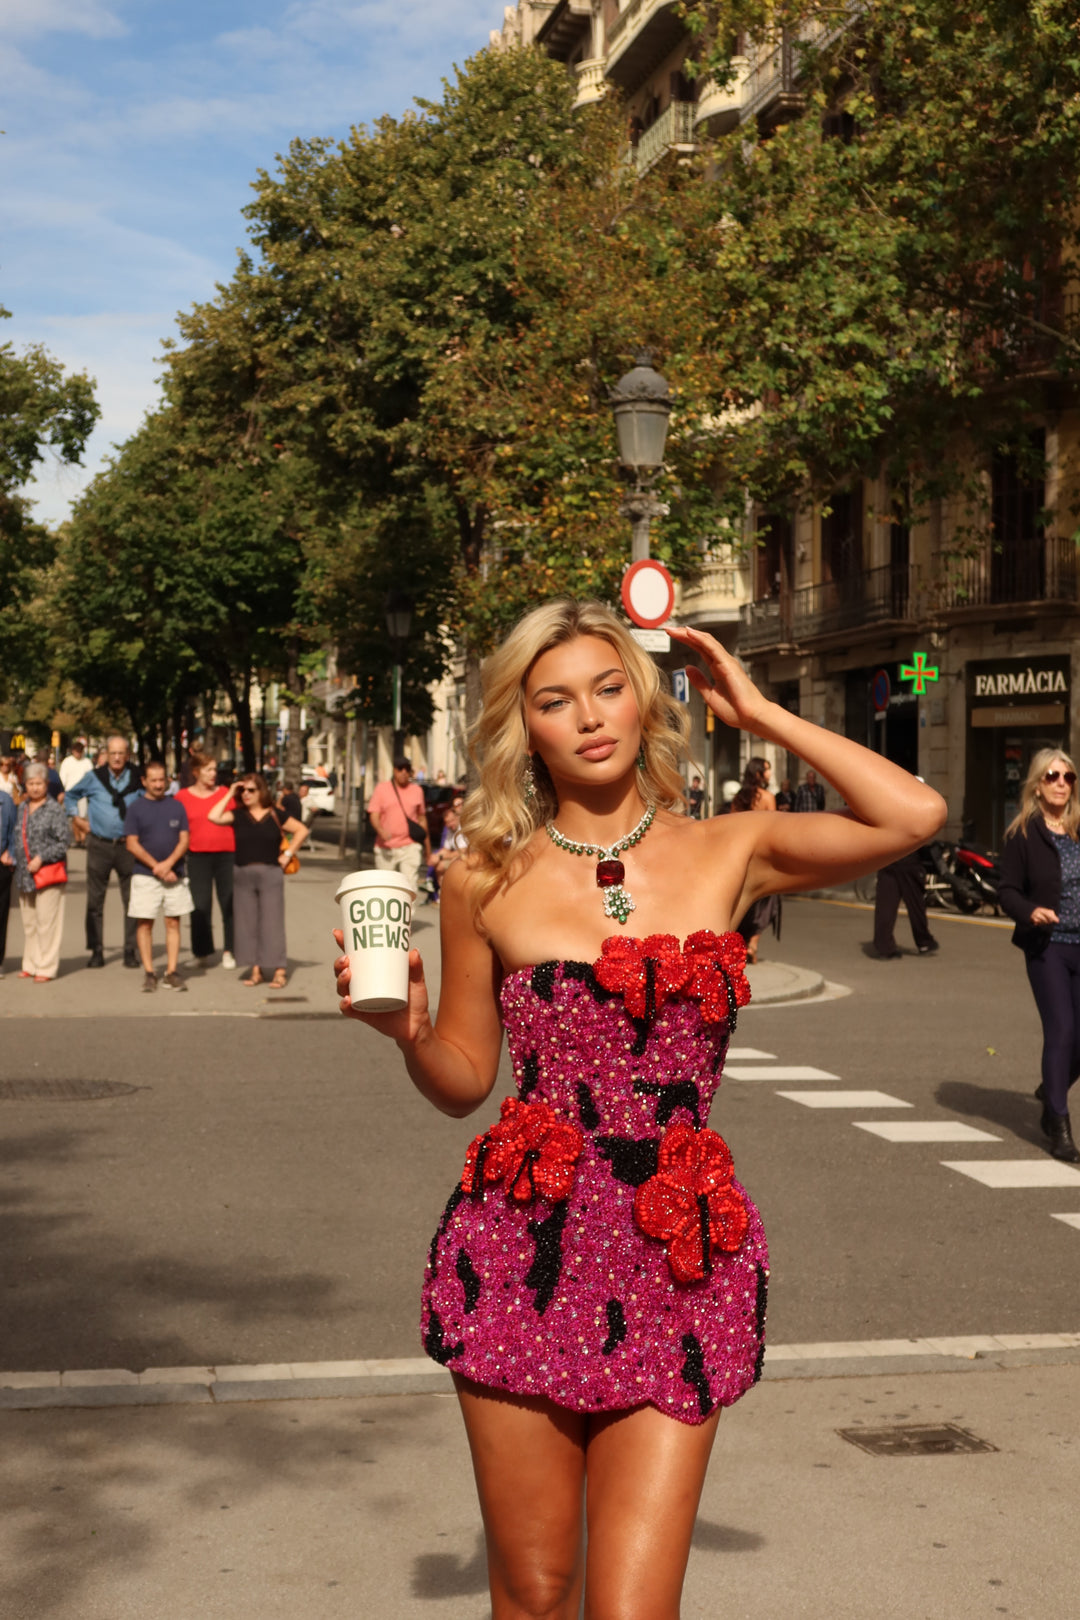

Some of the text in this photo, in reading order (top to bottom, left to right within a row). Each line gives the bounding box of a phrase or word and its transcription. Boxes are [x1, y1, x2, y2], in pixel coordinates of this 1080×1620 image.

[675, 674, 685, 700] P
[974, 668, 1067, 697] FARMÀCIA
[350, 897, 412, 926] GOOD
[352, 924, 410, 952] NEWS
